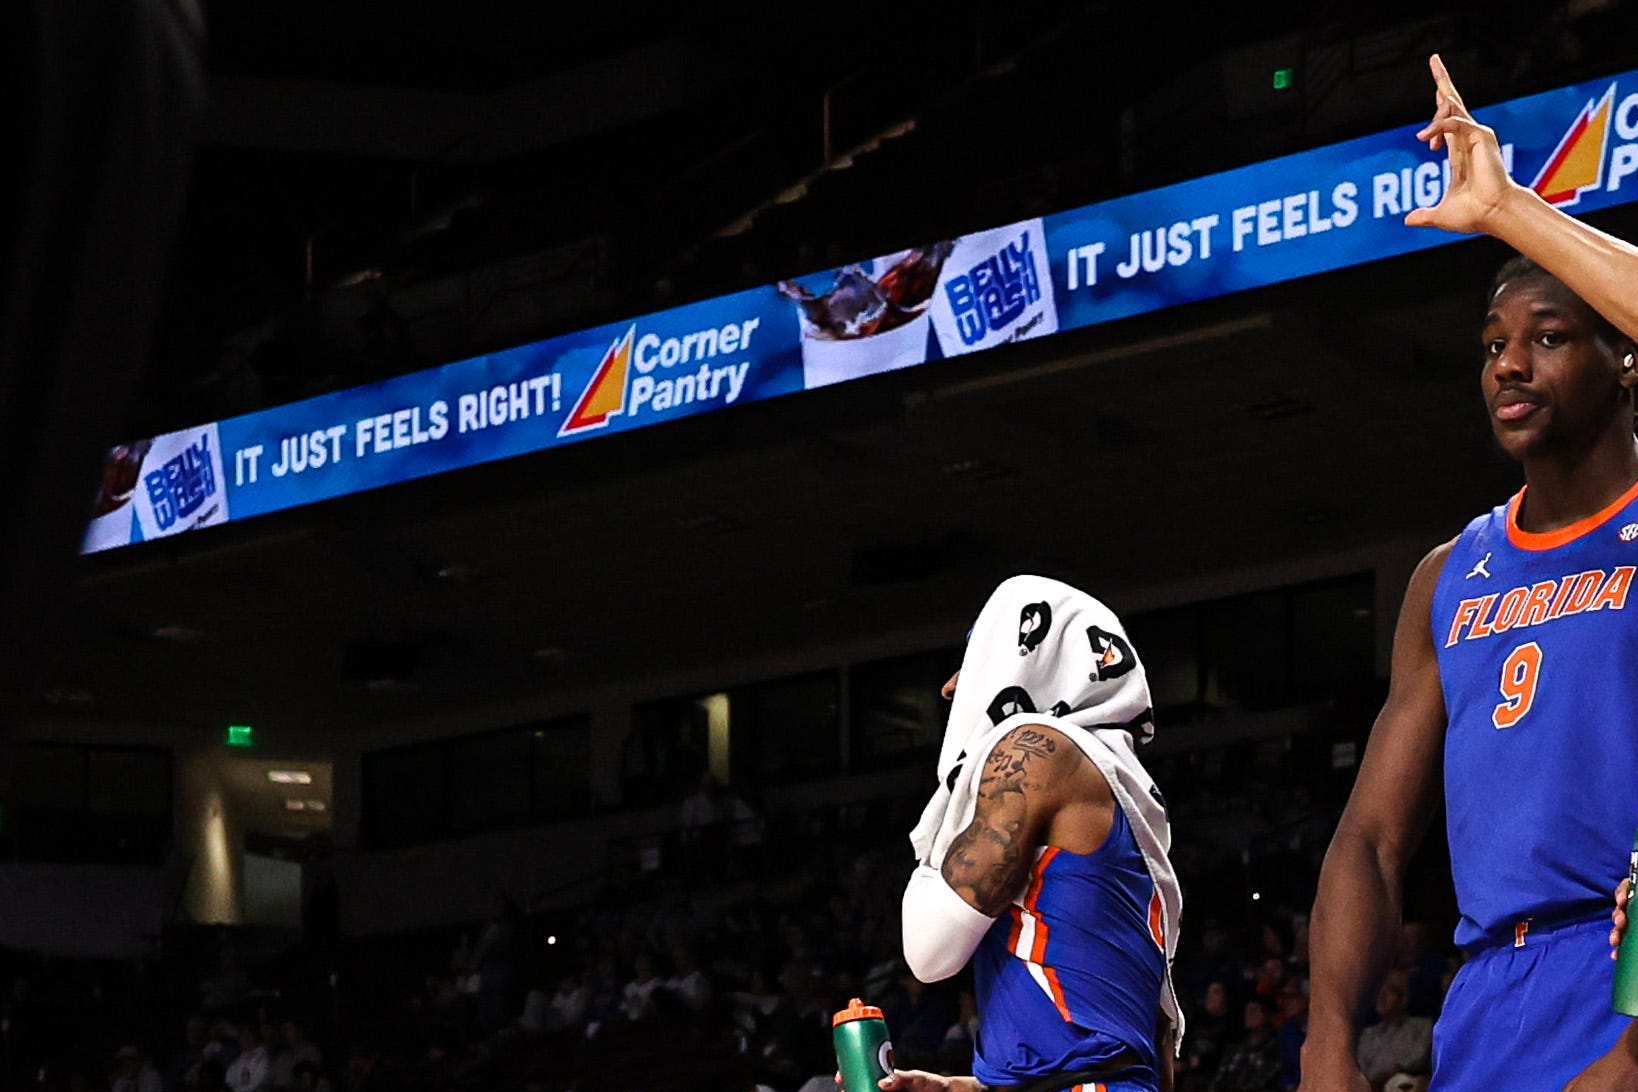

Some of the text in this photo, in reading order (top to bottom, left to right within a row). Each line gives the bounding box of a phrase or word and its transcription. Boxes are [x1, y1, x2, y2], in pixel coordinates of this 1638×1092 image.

[944, 230, 1029, 316] BELLY
[1067, 242, 1106, 290] IT
[1116, 214, 1219, 278] JUST
[1232, 182, 1358, 253] FEELS
[634, 317, 760, 373] Corner
[235, 372, 562, 486] IT JUST FEELS RIGHT!
[628, 361, 749, 416] Pantry
[1444, 565, 1638, 648] FLORIDA
[1492, 641, 1543, 729] 9
